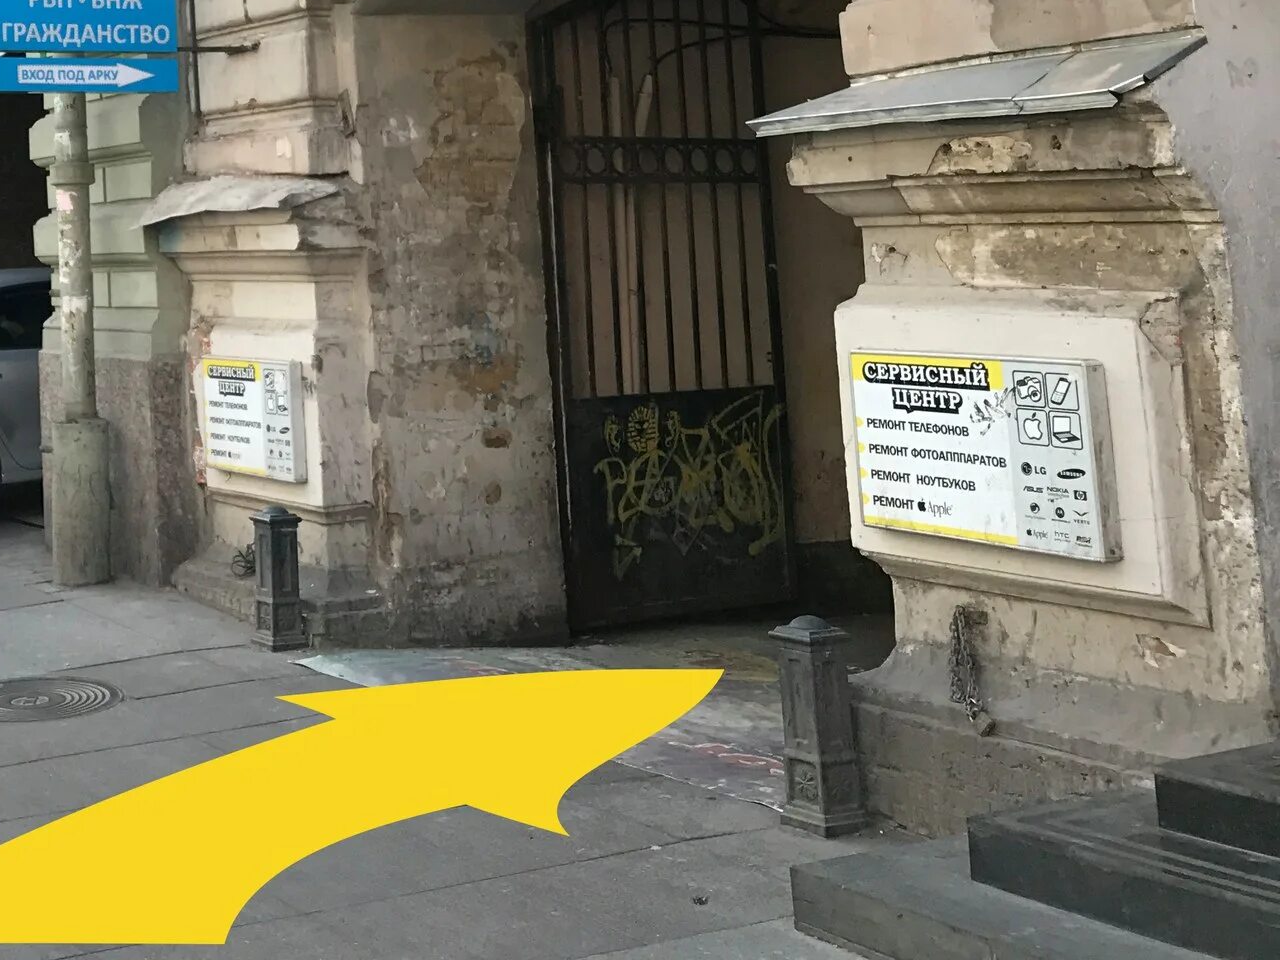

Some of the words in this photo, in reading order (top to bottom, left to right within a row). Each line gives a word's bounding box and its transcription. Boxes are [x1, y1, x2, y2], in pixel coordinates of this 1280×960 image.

[2, 22, 170, 47] ГРАЖДАНСТВО
[21, 66, 55, 82] ВХОД
[58, 65, 85, 82] ПОД
[88, 66, 119, 81] АРКУ
[208, 365, 255, 379] СЕРВИСНЫЙ
[863, 362, 989, 388] СЕРВИСНЫЙ
[219, 381, 245, 394] ЦЕНТР
[893, 388, 962, 411] ЦЕНТР
[866, 418, 906, 430] РЕМОНТ
[908, 421, 969, 437] ТЕЛЕФОНОВ
[869, 444, 908, 457] РЕМОНТ
[871, 469, 910, 483] РЕМОНТ
[916, 474, 976, 491] НОУТБУКОВ
[1034, 466, 1047, 475] LG
[873, 495, 914, 510] РЕМОНТ
[928, 501, 953, 517] Apple
